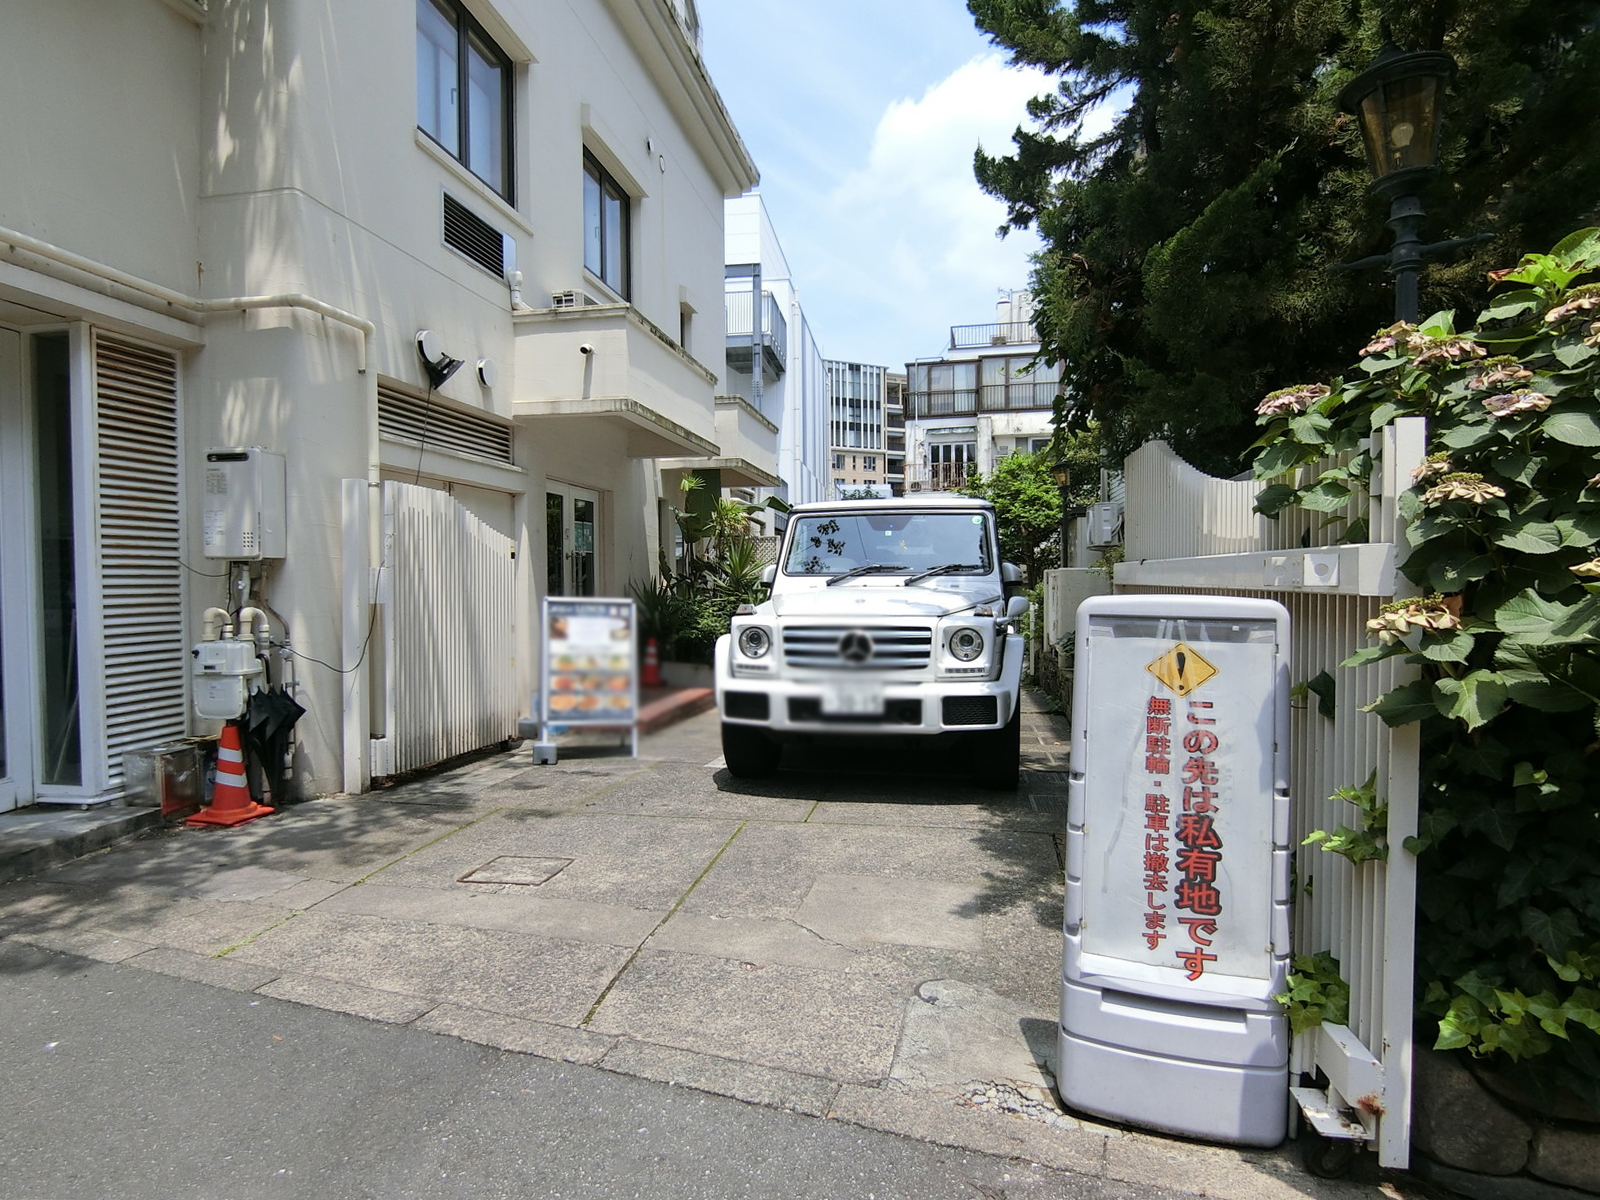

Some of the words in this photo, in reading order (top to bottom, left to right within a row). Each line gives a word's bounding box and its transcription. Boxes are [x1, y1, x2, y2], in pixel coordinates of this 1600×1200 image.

[1142, 696, 1171, 950] 無断駐輪・駐車は撤去します
[1175, 700, 1223, 981] この先は私有地です
